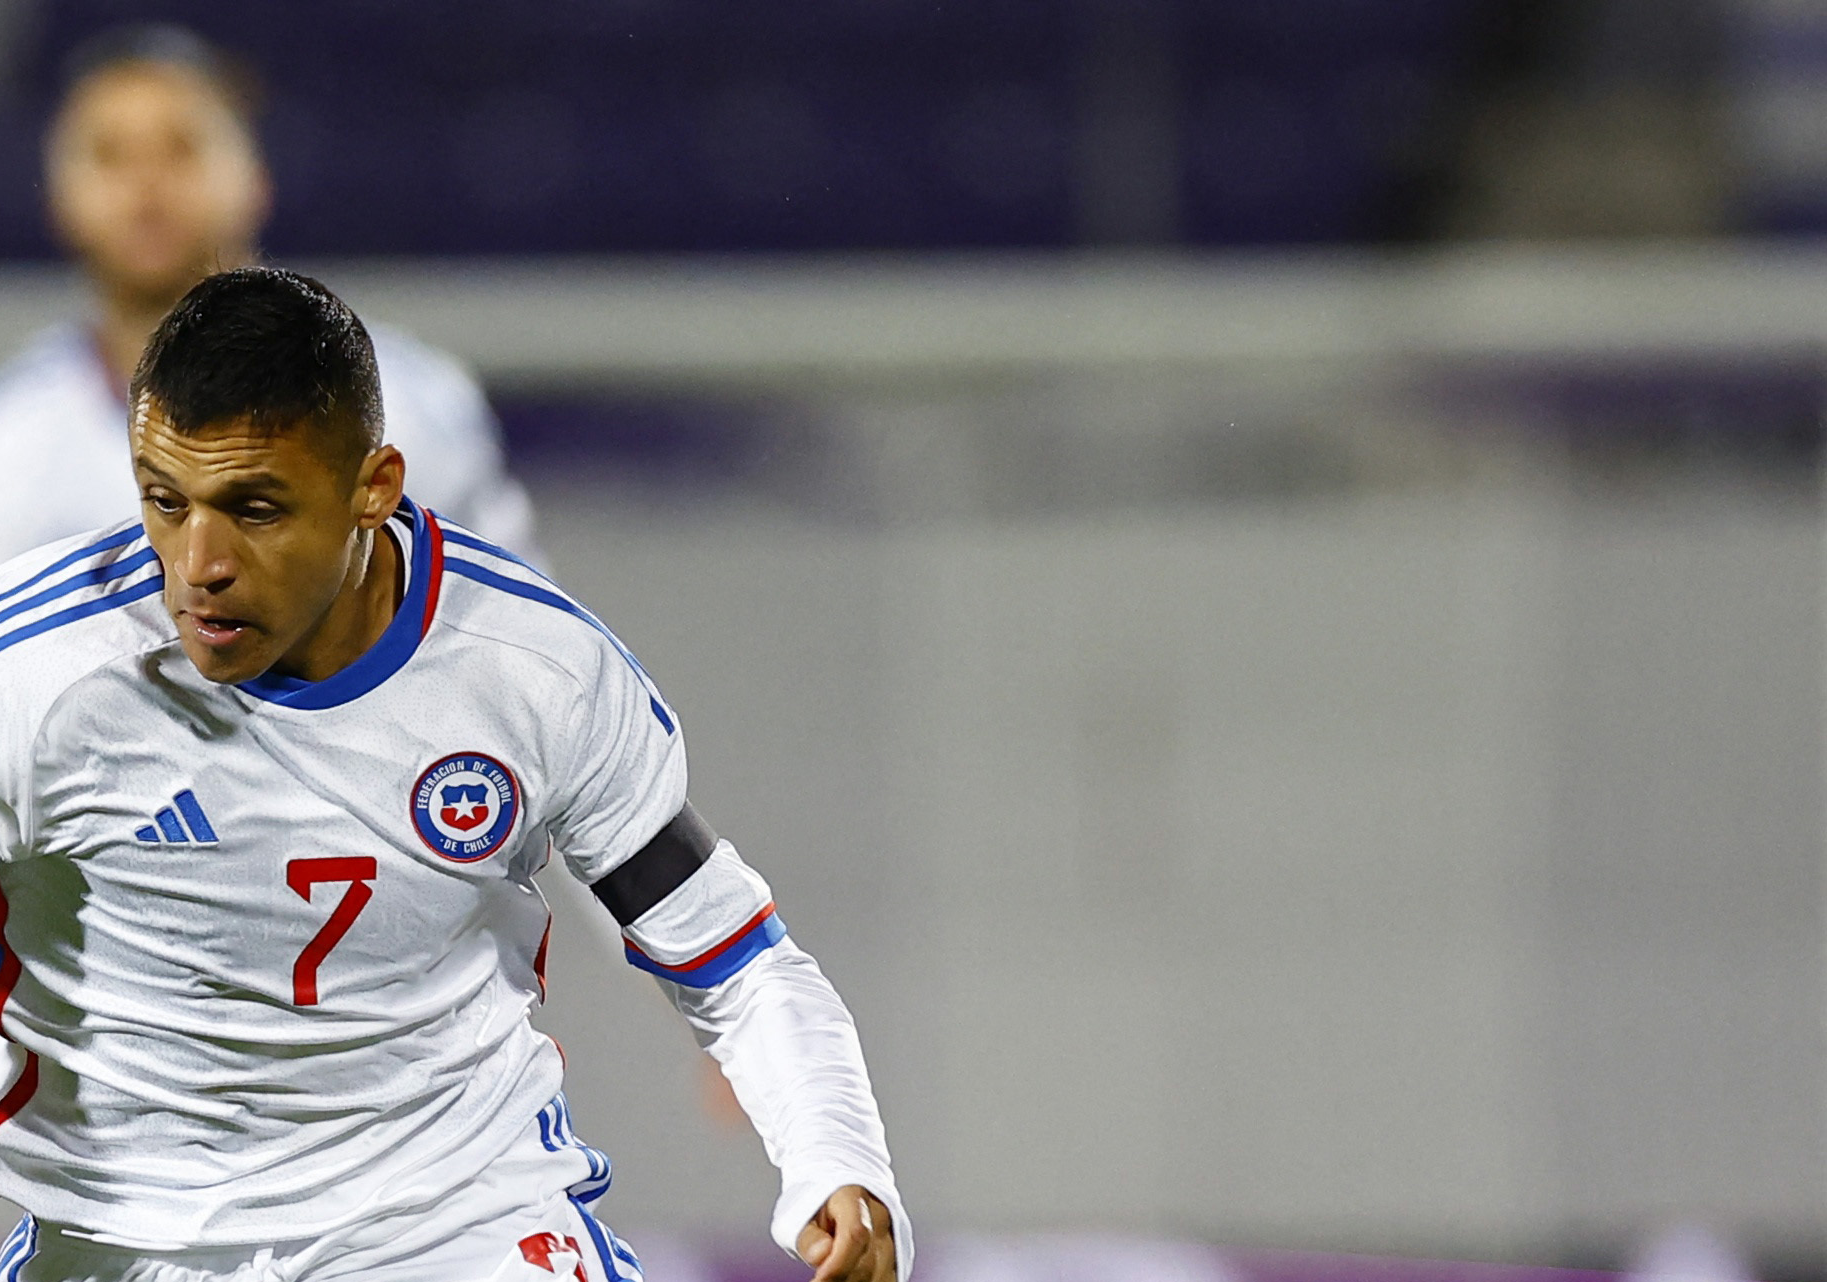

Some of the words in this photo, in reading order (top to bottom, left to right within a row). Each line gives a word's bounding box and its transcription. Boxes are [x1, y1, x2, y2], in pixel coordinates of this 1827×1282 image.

[417, 760, 465, 810] FEDERACION
[472, 760, 489, 773] DE
[488, 769, 512, 806] FUTBOL
[443, 841, 458, 852] DE
[463, 835, 492, 854] CHILE
[287, 856, 377, 1005] 7
